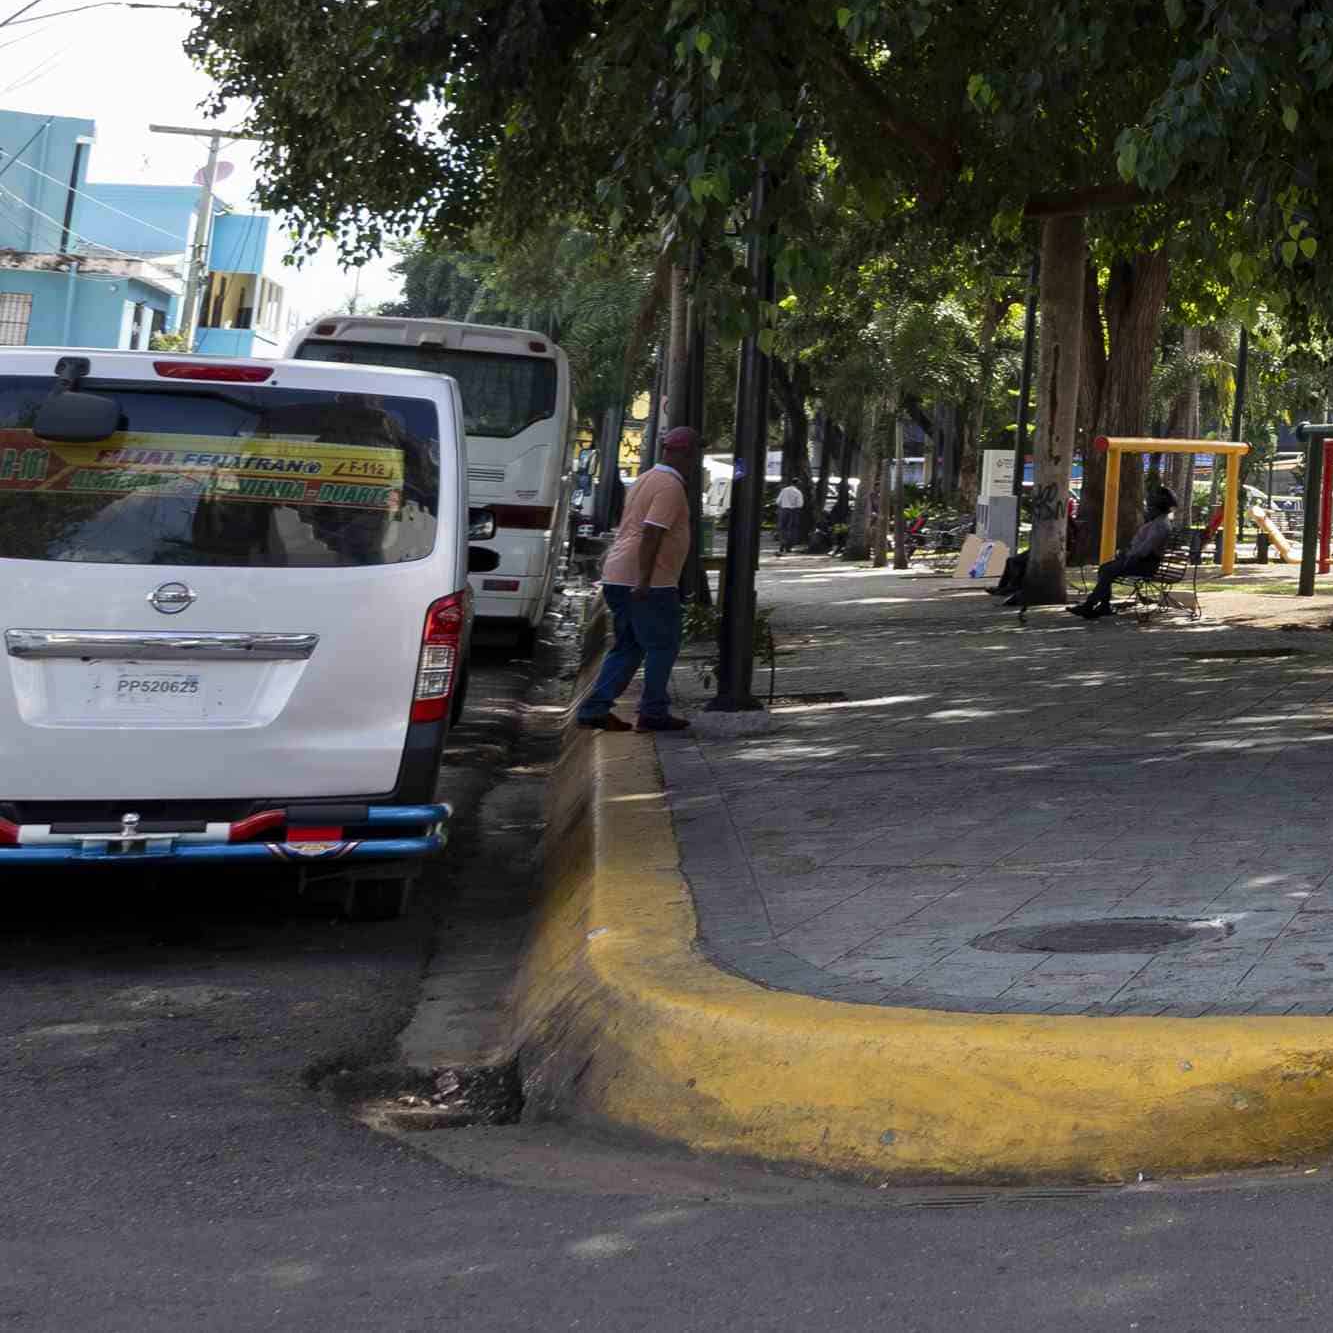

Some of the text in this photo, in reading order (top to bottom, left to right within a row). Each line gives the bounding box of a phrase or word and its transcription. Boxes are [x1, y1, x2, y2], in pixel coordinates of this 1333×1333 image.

[95, 449, 176, 465] FILIAL
[349, 461, 385, 476] F-112
[319, 481, 393, 505] DUARTE
[117, 680, 199, 693] PP520625
